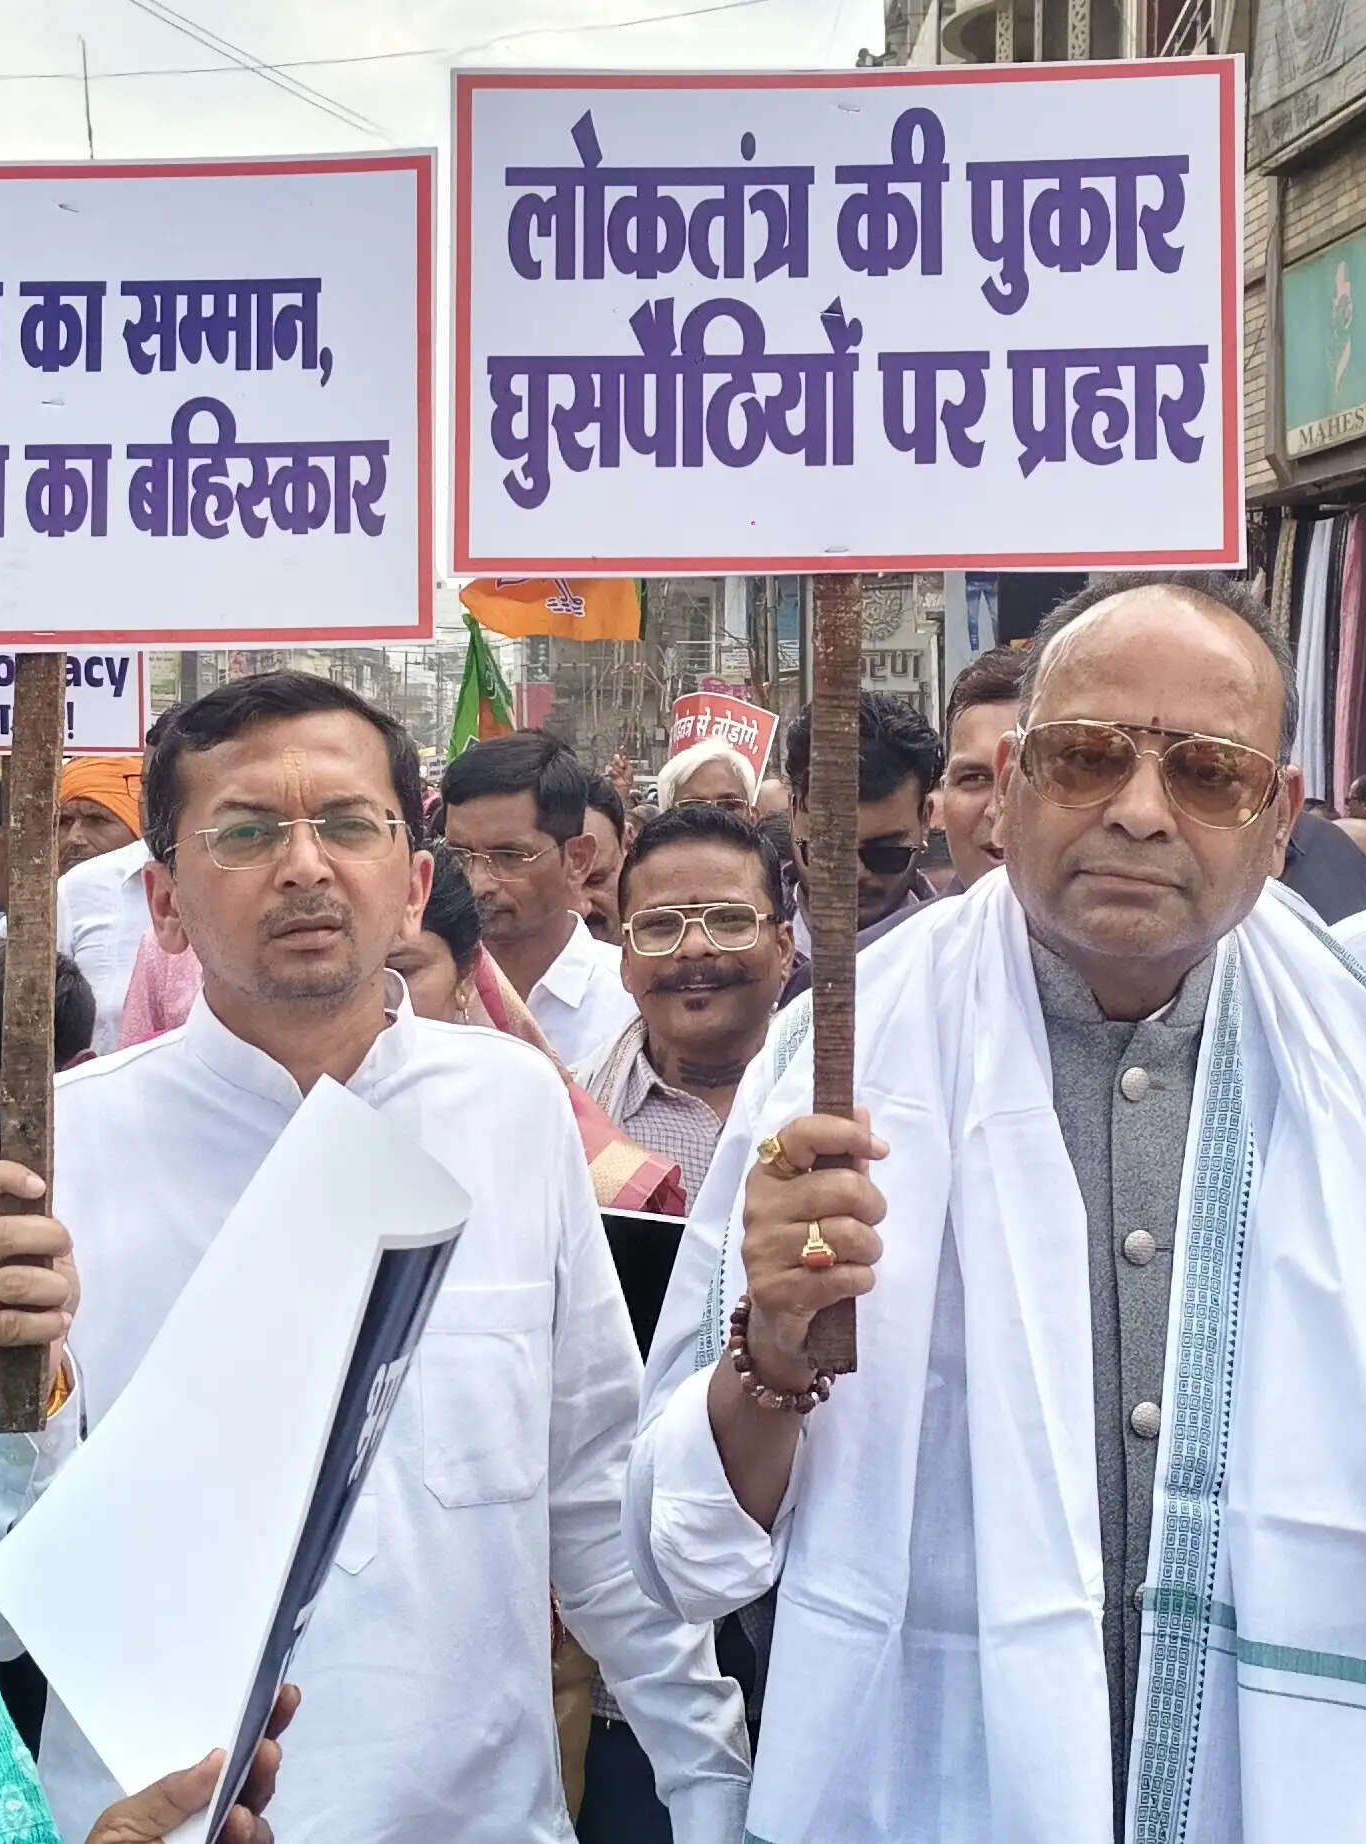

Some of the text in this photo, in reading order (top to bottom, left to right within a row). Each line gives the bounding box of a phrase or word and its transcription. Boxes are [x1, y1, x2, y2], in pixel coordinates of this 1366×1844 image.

[505, 107, 1190, 316] लोकतंत्र की पुकार
[20, 280, 107, 373] का
[121, 277, 333, 387] सम्मान,
[487, 296, 1209, 510] घुसपैठियों पर प्रहार
[25, 443, 113, 538] का
[696, 706, 712, 738] से
